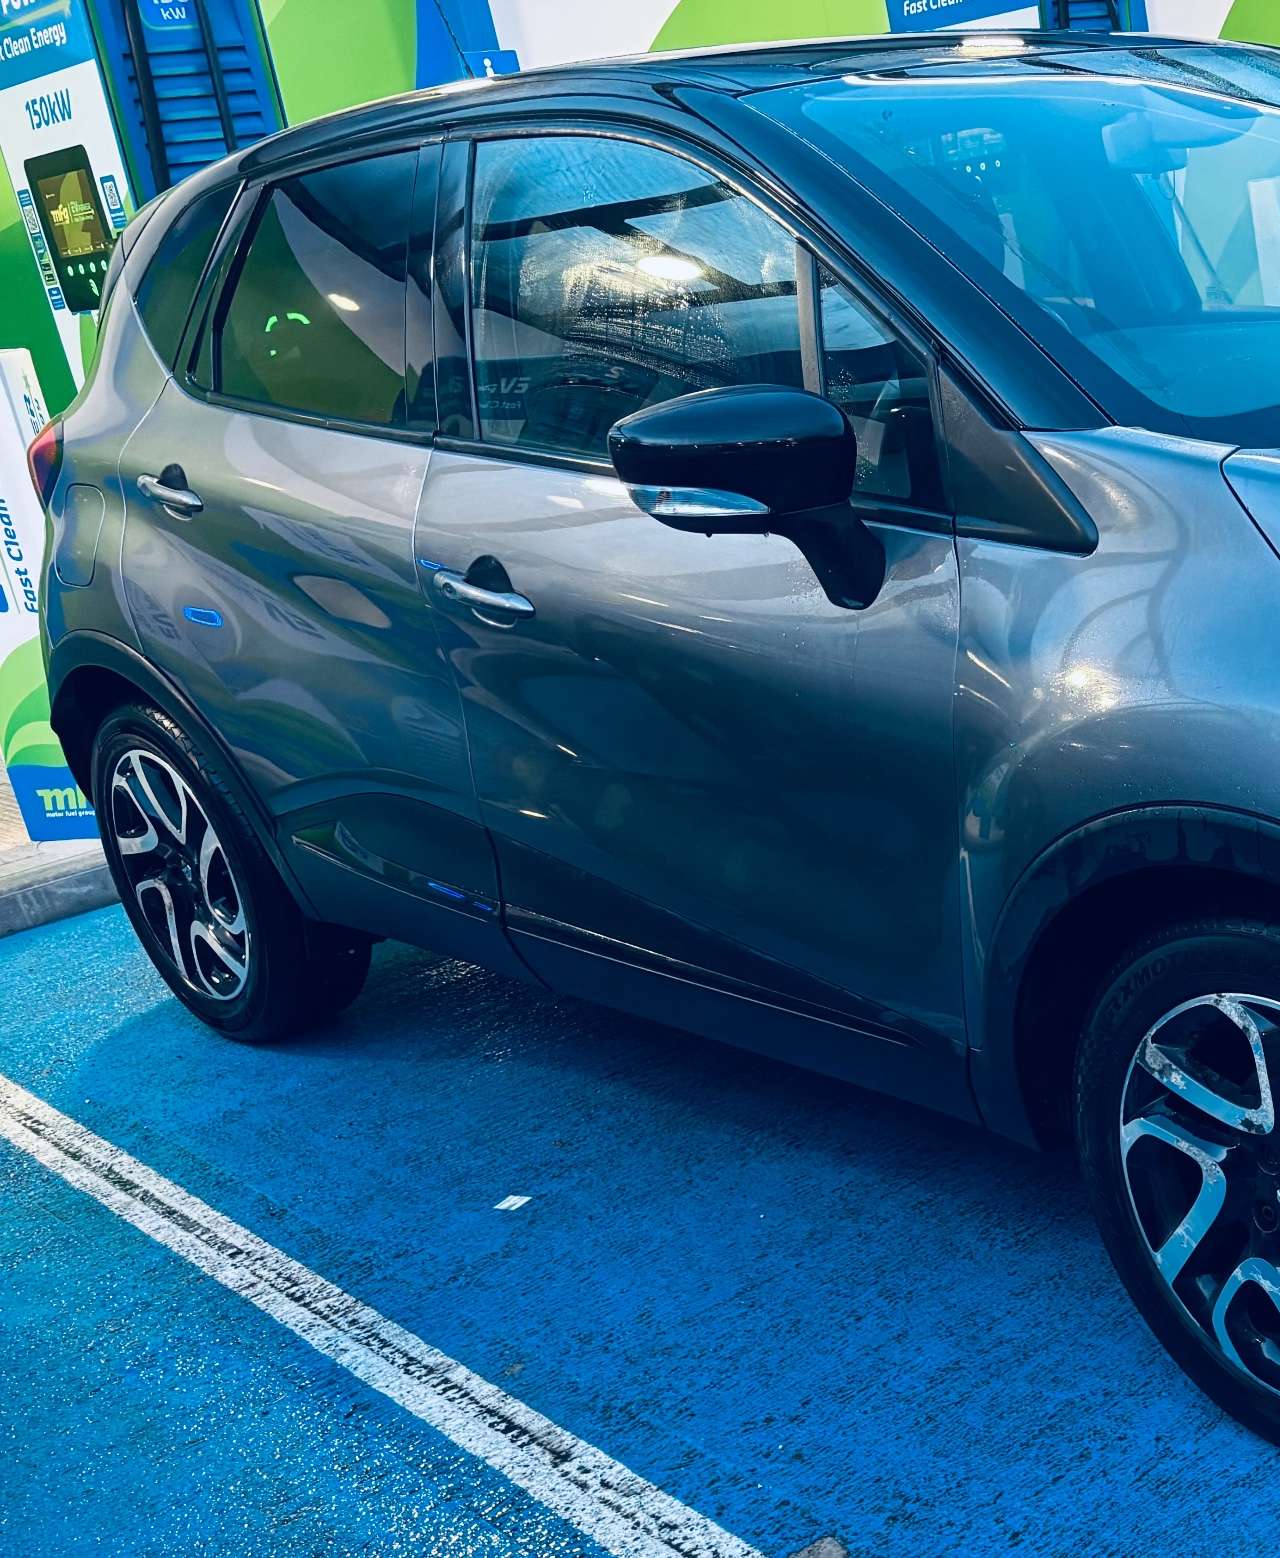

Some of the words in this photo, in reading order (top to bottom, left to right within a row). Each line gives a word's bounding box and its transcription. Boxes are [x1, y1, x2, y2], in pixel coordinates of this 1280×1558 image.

[160, 7, 186, 20] kW
[904, 0, 928, 16] Fast
[3, 36, 31, 59] Clean
[30, 22, 67, 49] Energy
[25, 87, 72, 130] 150kW
[15, 567, 39, 613] Fast
